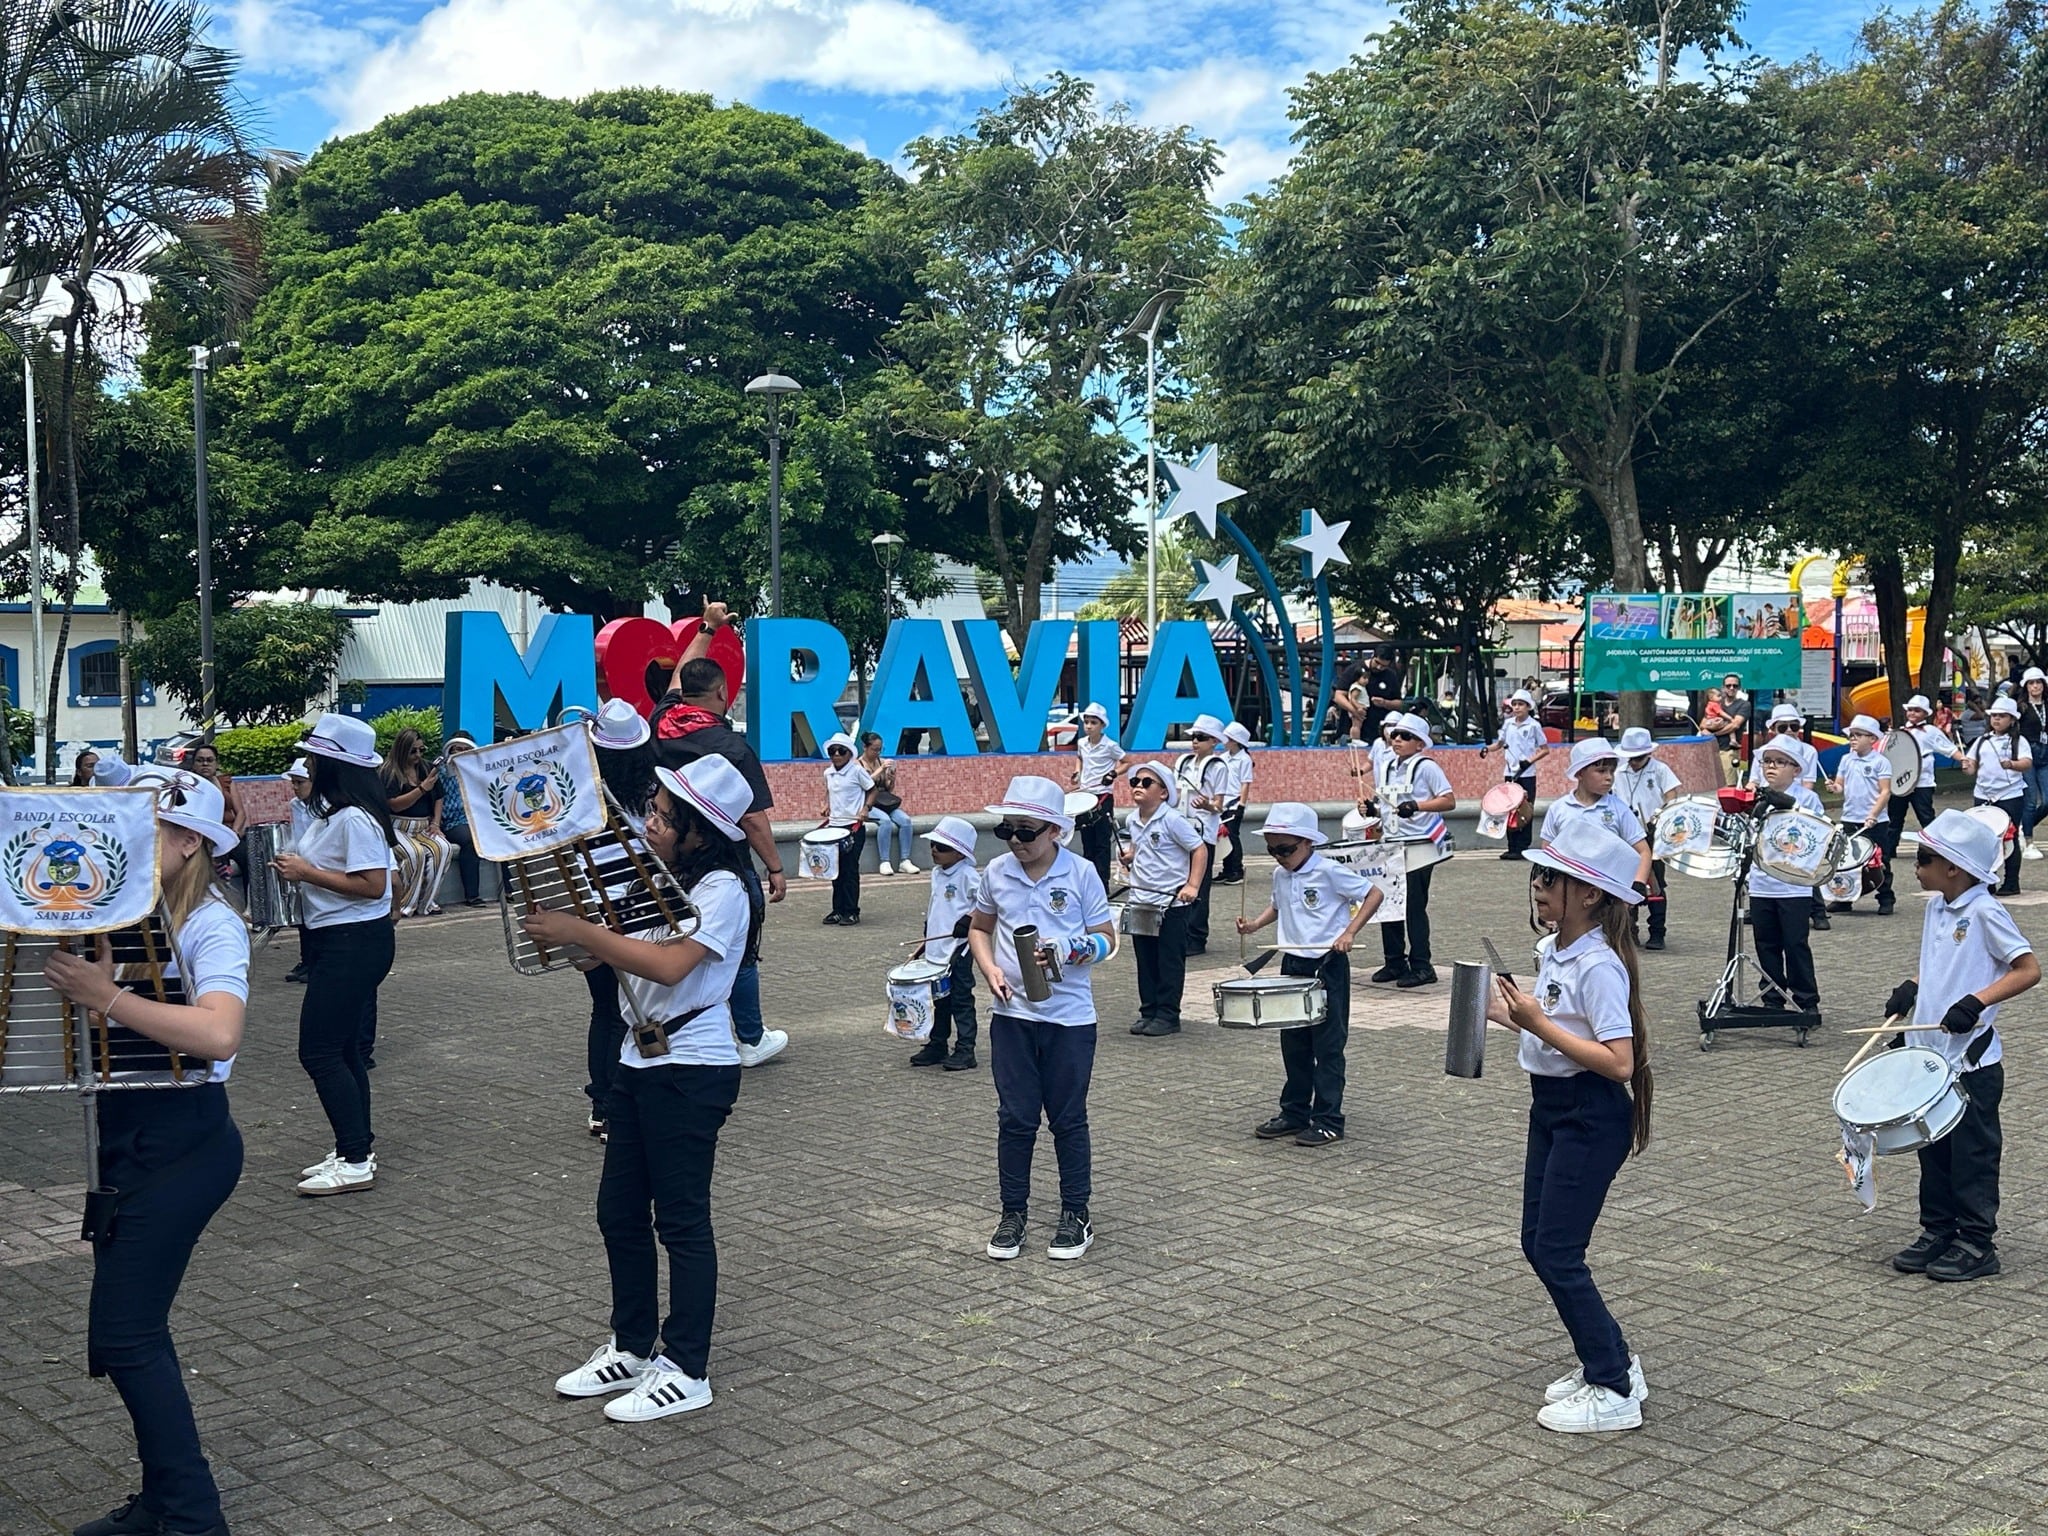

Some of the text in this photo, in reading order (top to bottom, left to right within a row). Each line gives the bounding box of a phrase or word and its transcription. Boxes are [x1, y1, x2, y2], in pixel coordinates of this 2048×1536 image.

[485, 745, 559, 772] BANDA ESCOLAR
[14, 811, 116, 824] BANDA ESCOLAR
[523, 833, 541, 843] SAN
[34, 910, 95, 921] SAN BLAS
